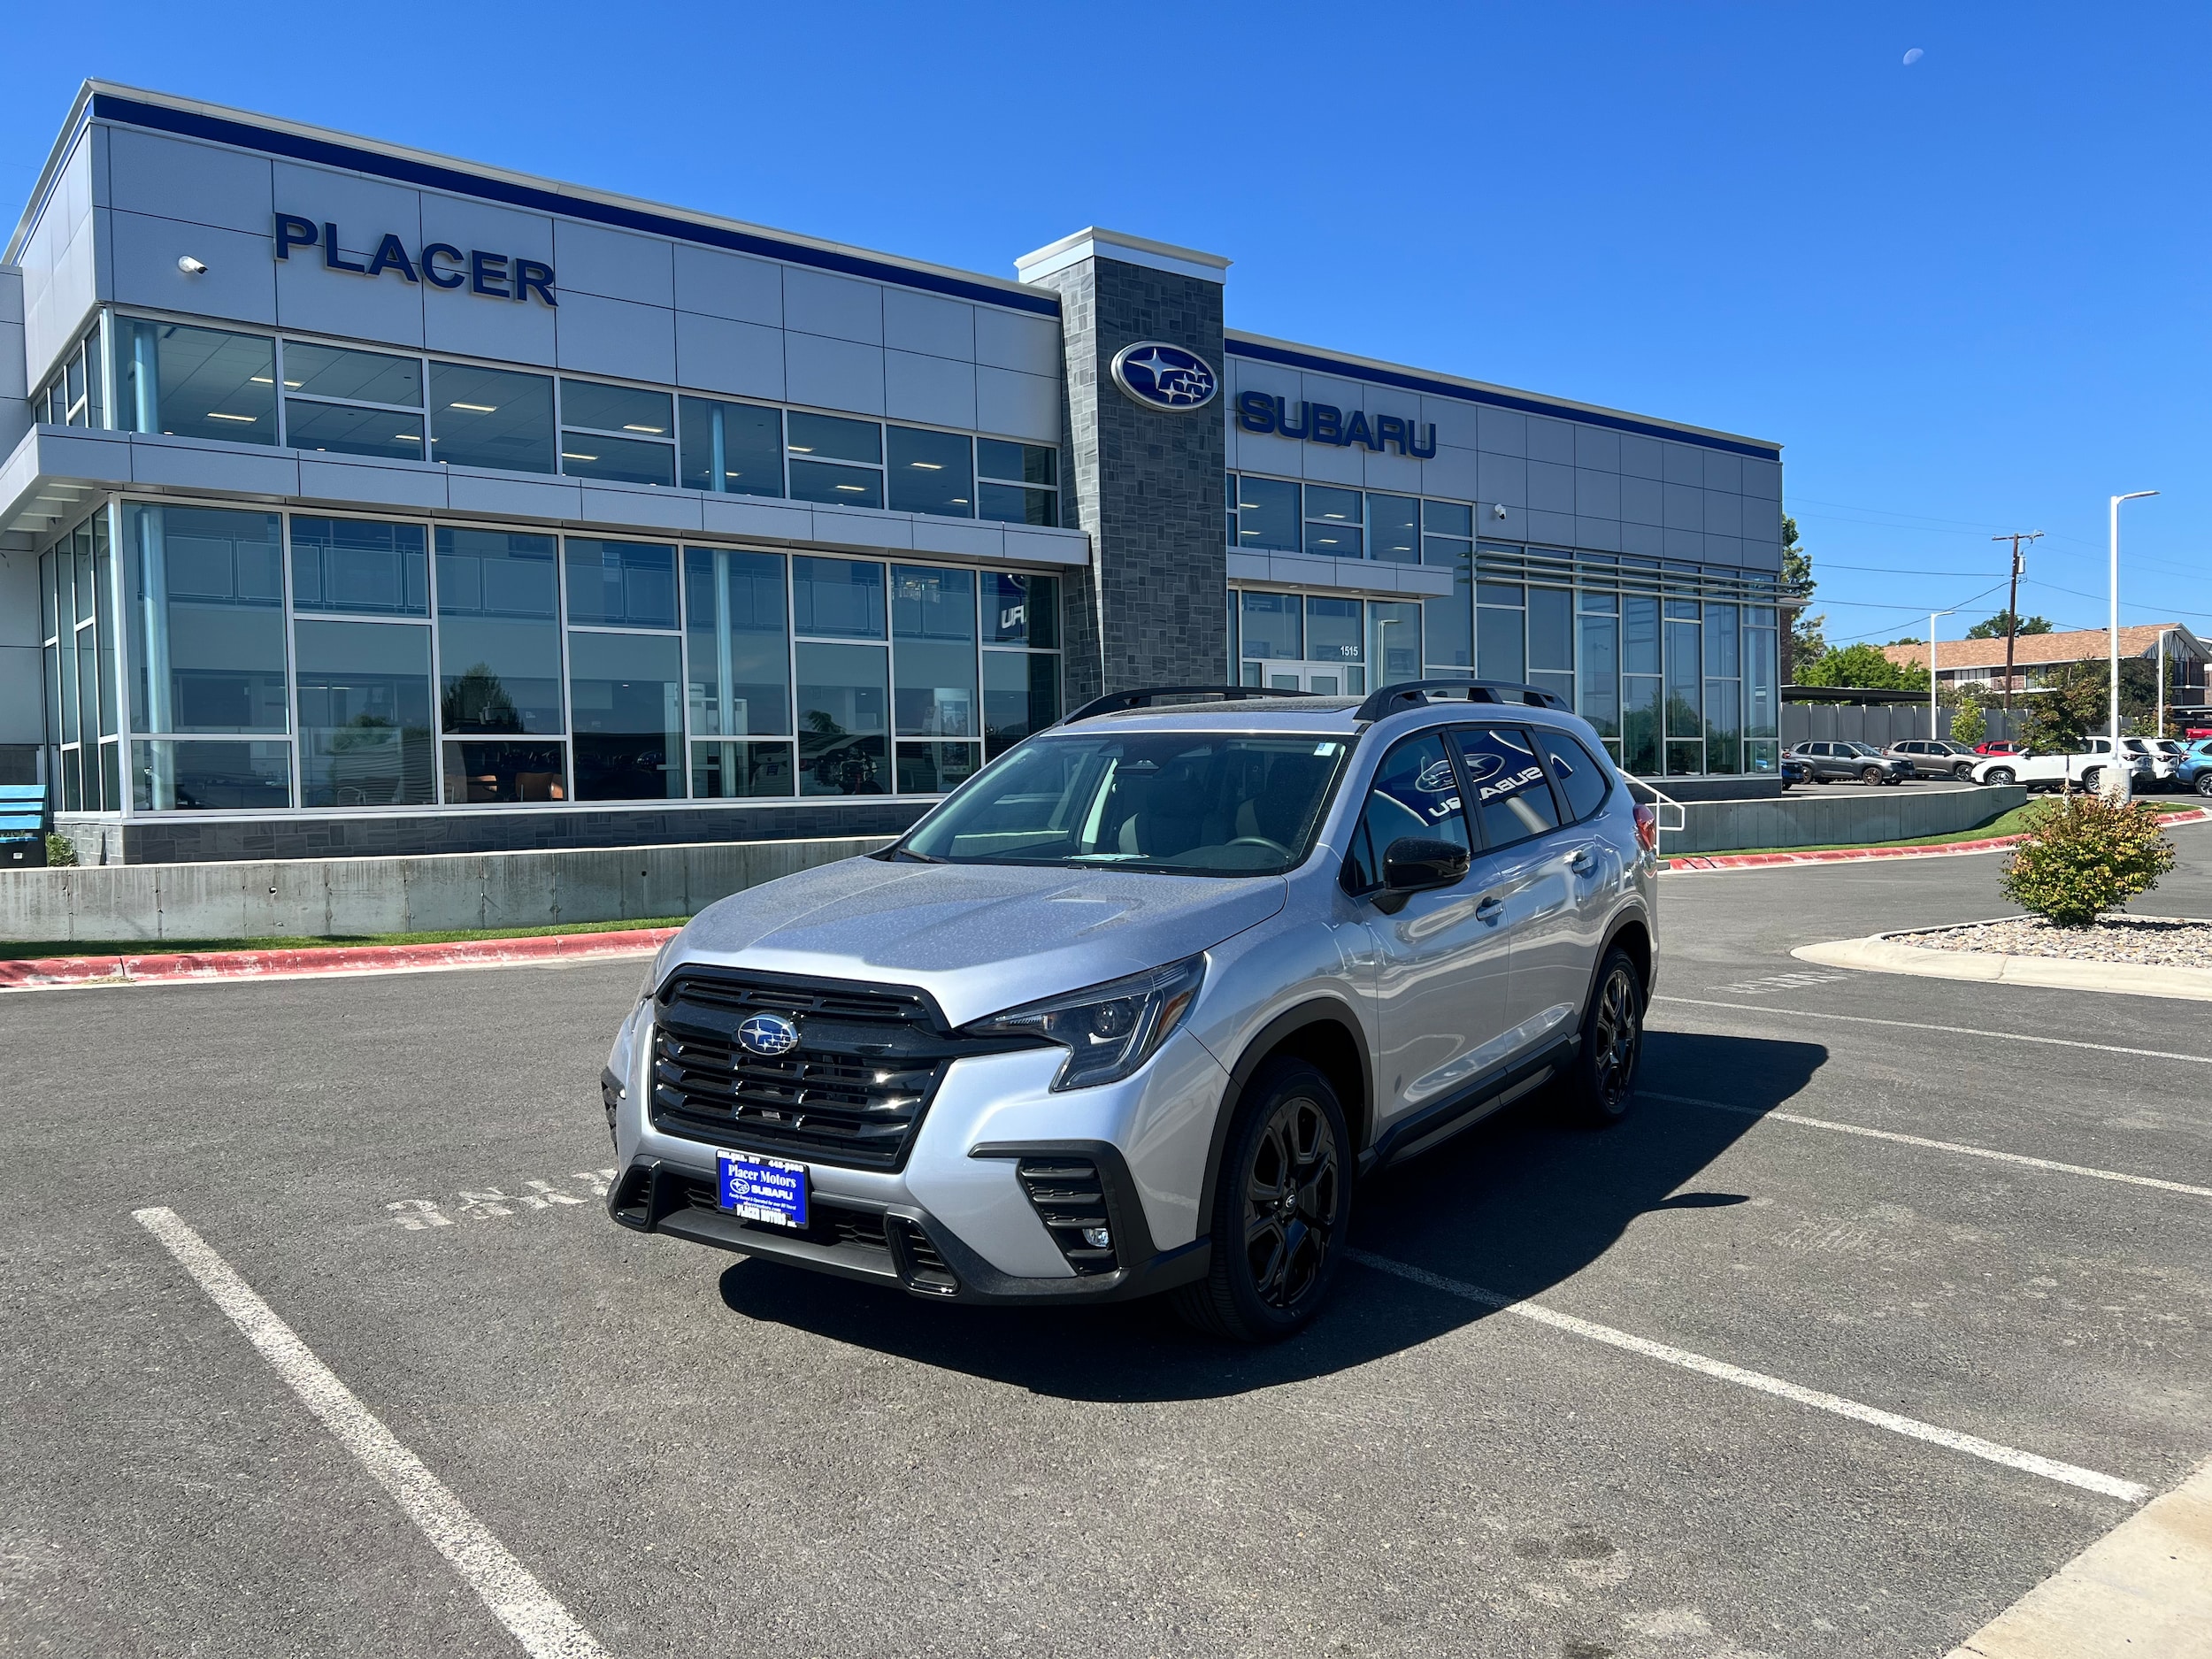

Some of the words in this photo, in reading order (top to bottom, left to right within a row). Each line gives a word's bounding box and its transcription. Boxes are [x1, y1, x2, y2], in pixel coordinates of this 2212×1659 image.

[273, 211, 559, 307] PLACER
[1239, 390, 1437, 460] SUBARU
[1340, 645, 1359, 657] 1515
[728, 1164, 759, 1181] Placer
[760, 1170, 797, 1188] Motors
[750, 1185, 794, 1201] SUBARU
